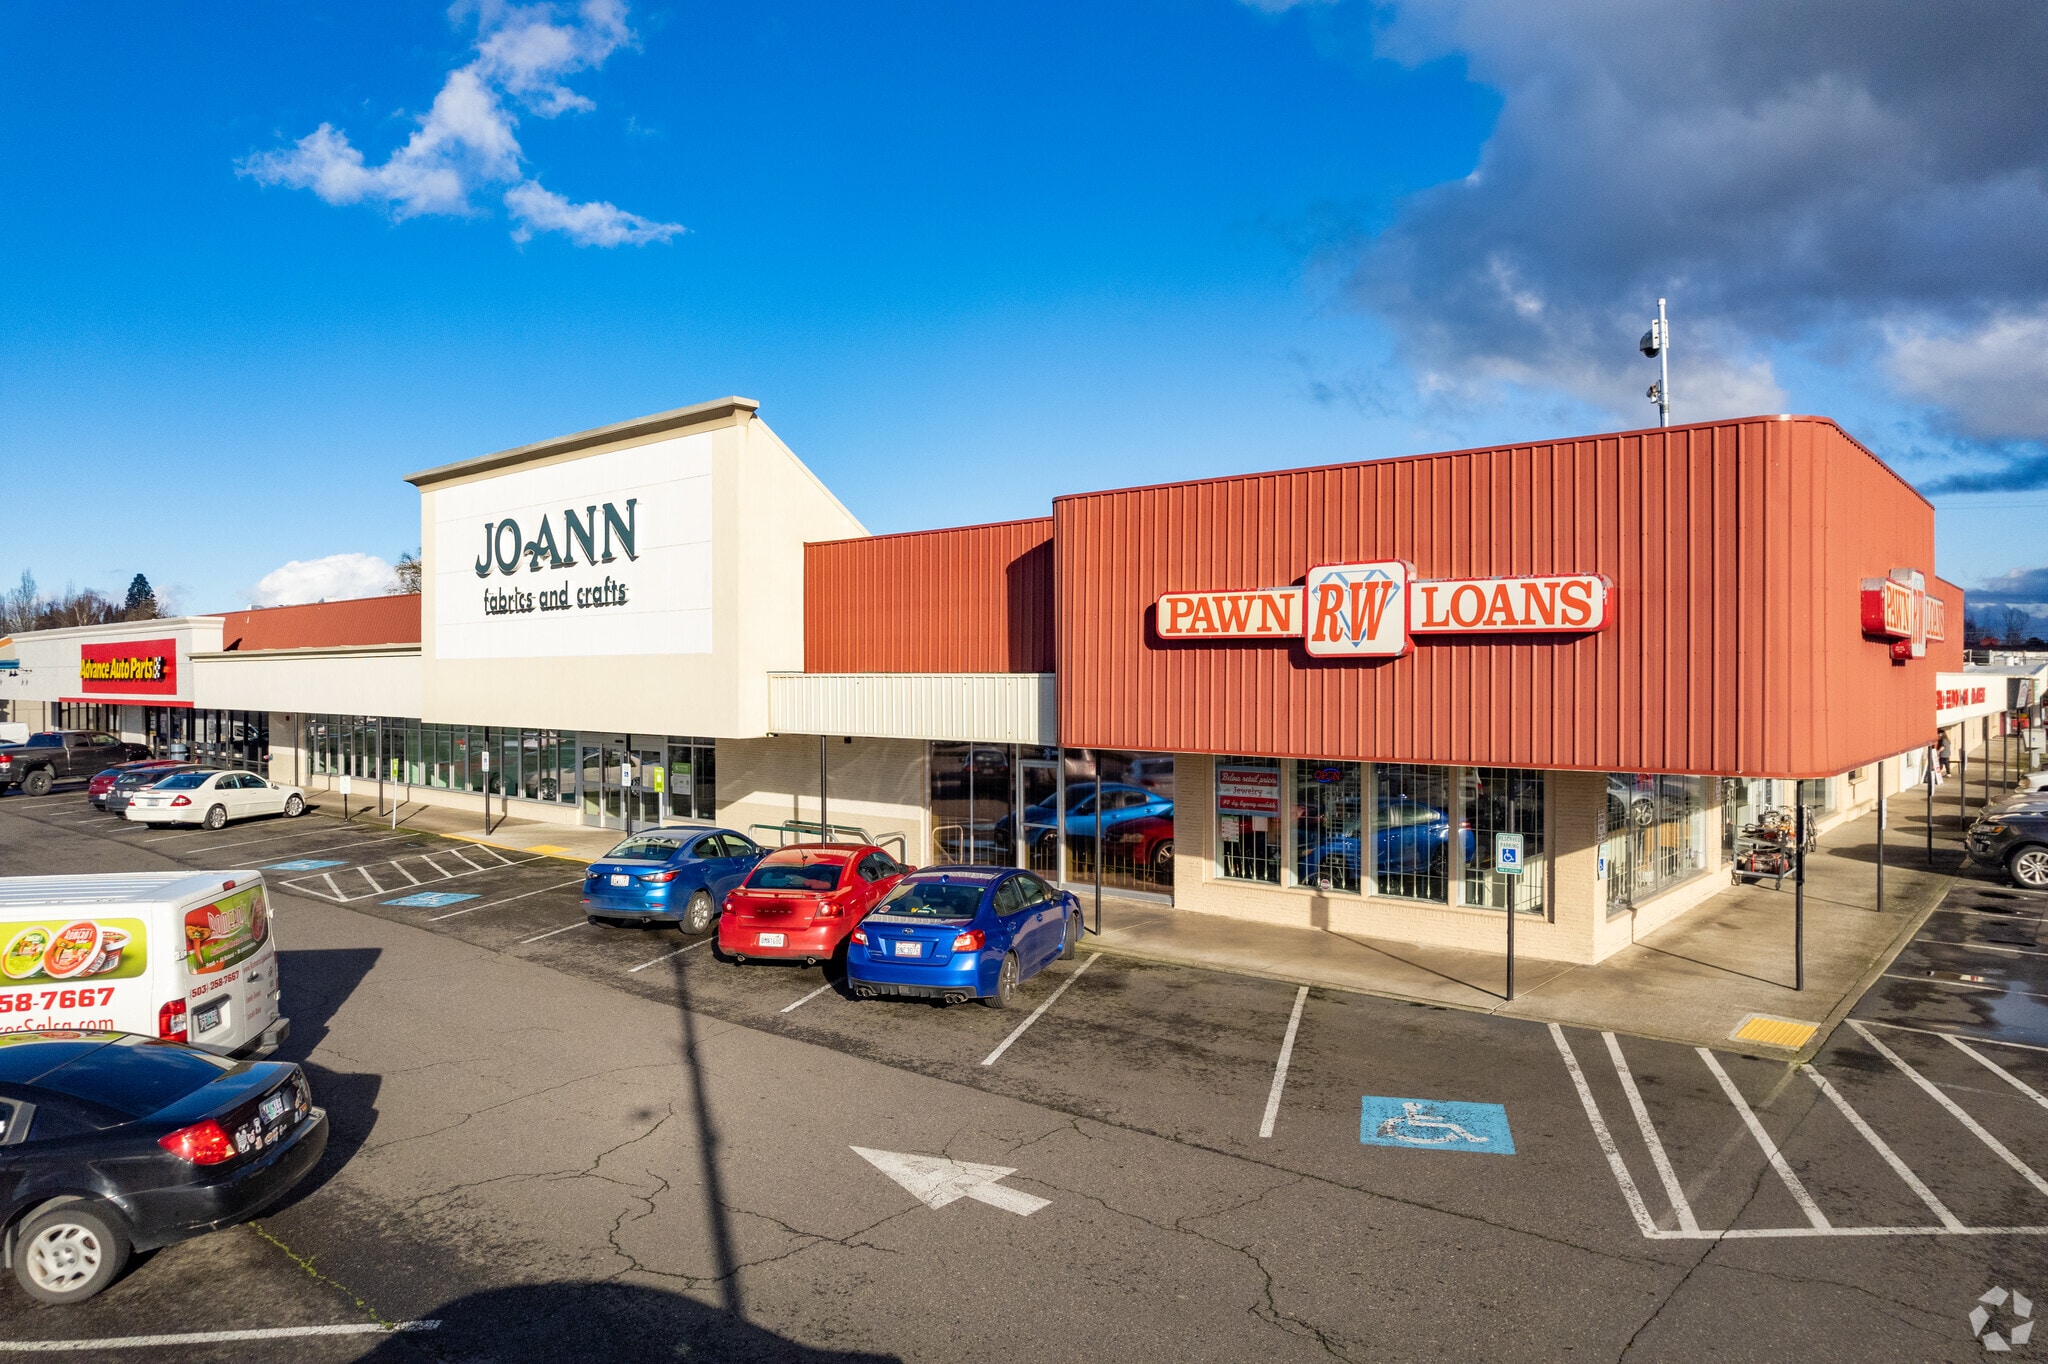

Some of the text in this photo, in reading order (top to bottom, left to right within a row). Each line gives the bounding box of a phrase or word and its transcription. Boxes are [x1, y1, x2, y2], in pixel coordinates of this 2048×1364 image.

[484, 576, 626, 613] fabrics and crafts
[1885, 585, 1911, 633] PAWN
[1166, 580, 1594, 643] PAWN RW LOANS
[80, 657, 153, 679] Advance Auto Parts
[1313, 770, 1342, 781] OPEN
[1233, 786, 1263, 797] Jewelry
[190, 970, 240, 1000] (503) 258-7667
